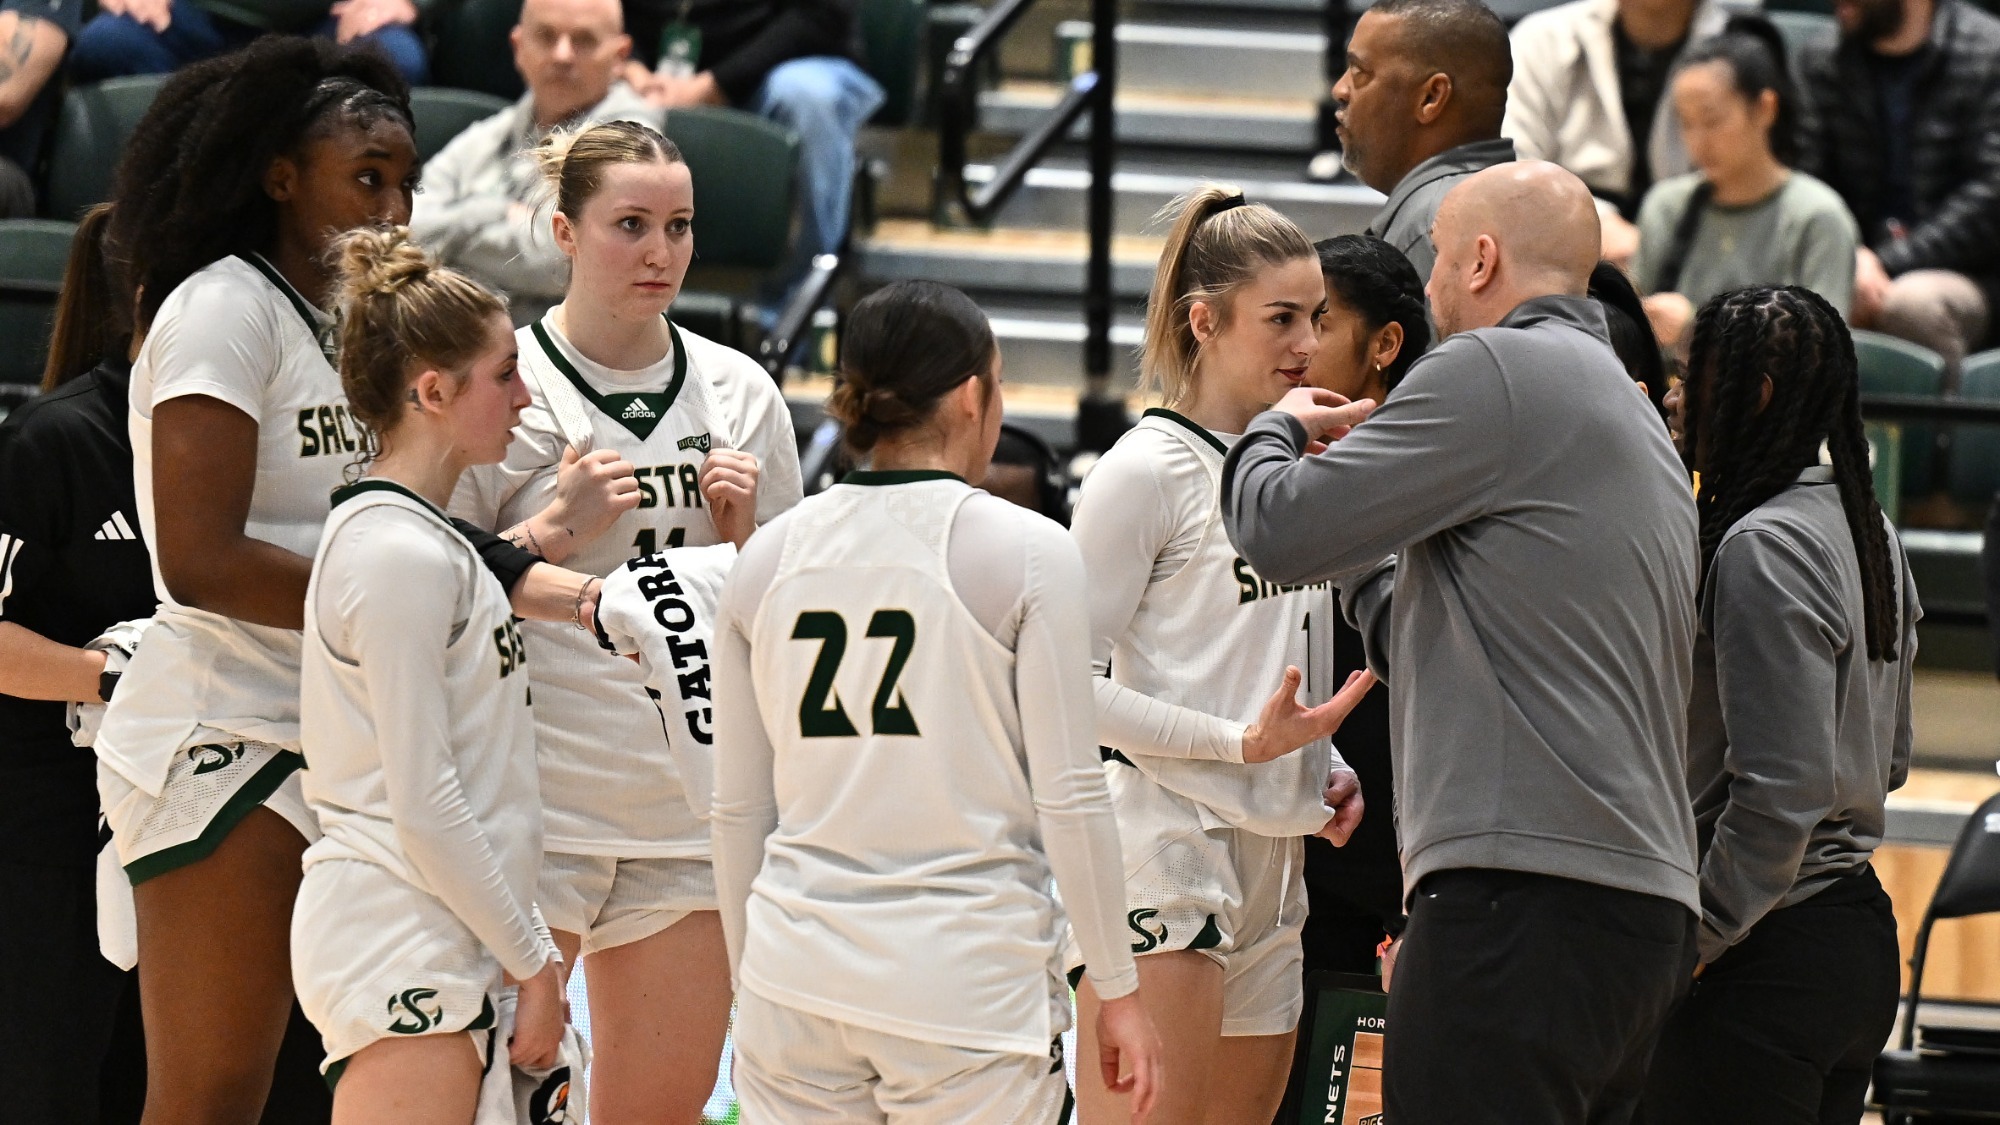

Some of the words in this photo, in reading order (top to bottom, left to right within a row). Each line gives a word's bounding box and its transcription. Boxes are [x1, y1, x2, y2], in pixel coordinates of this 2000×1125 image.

[621, 409, 657, 420] adidas
[789, 608, 922, 738] 22
[1324, 1044, 1346, 1124] NETS
